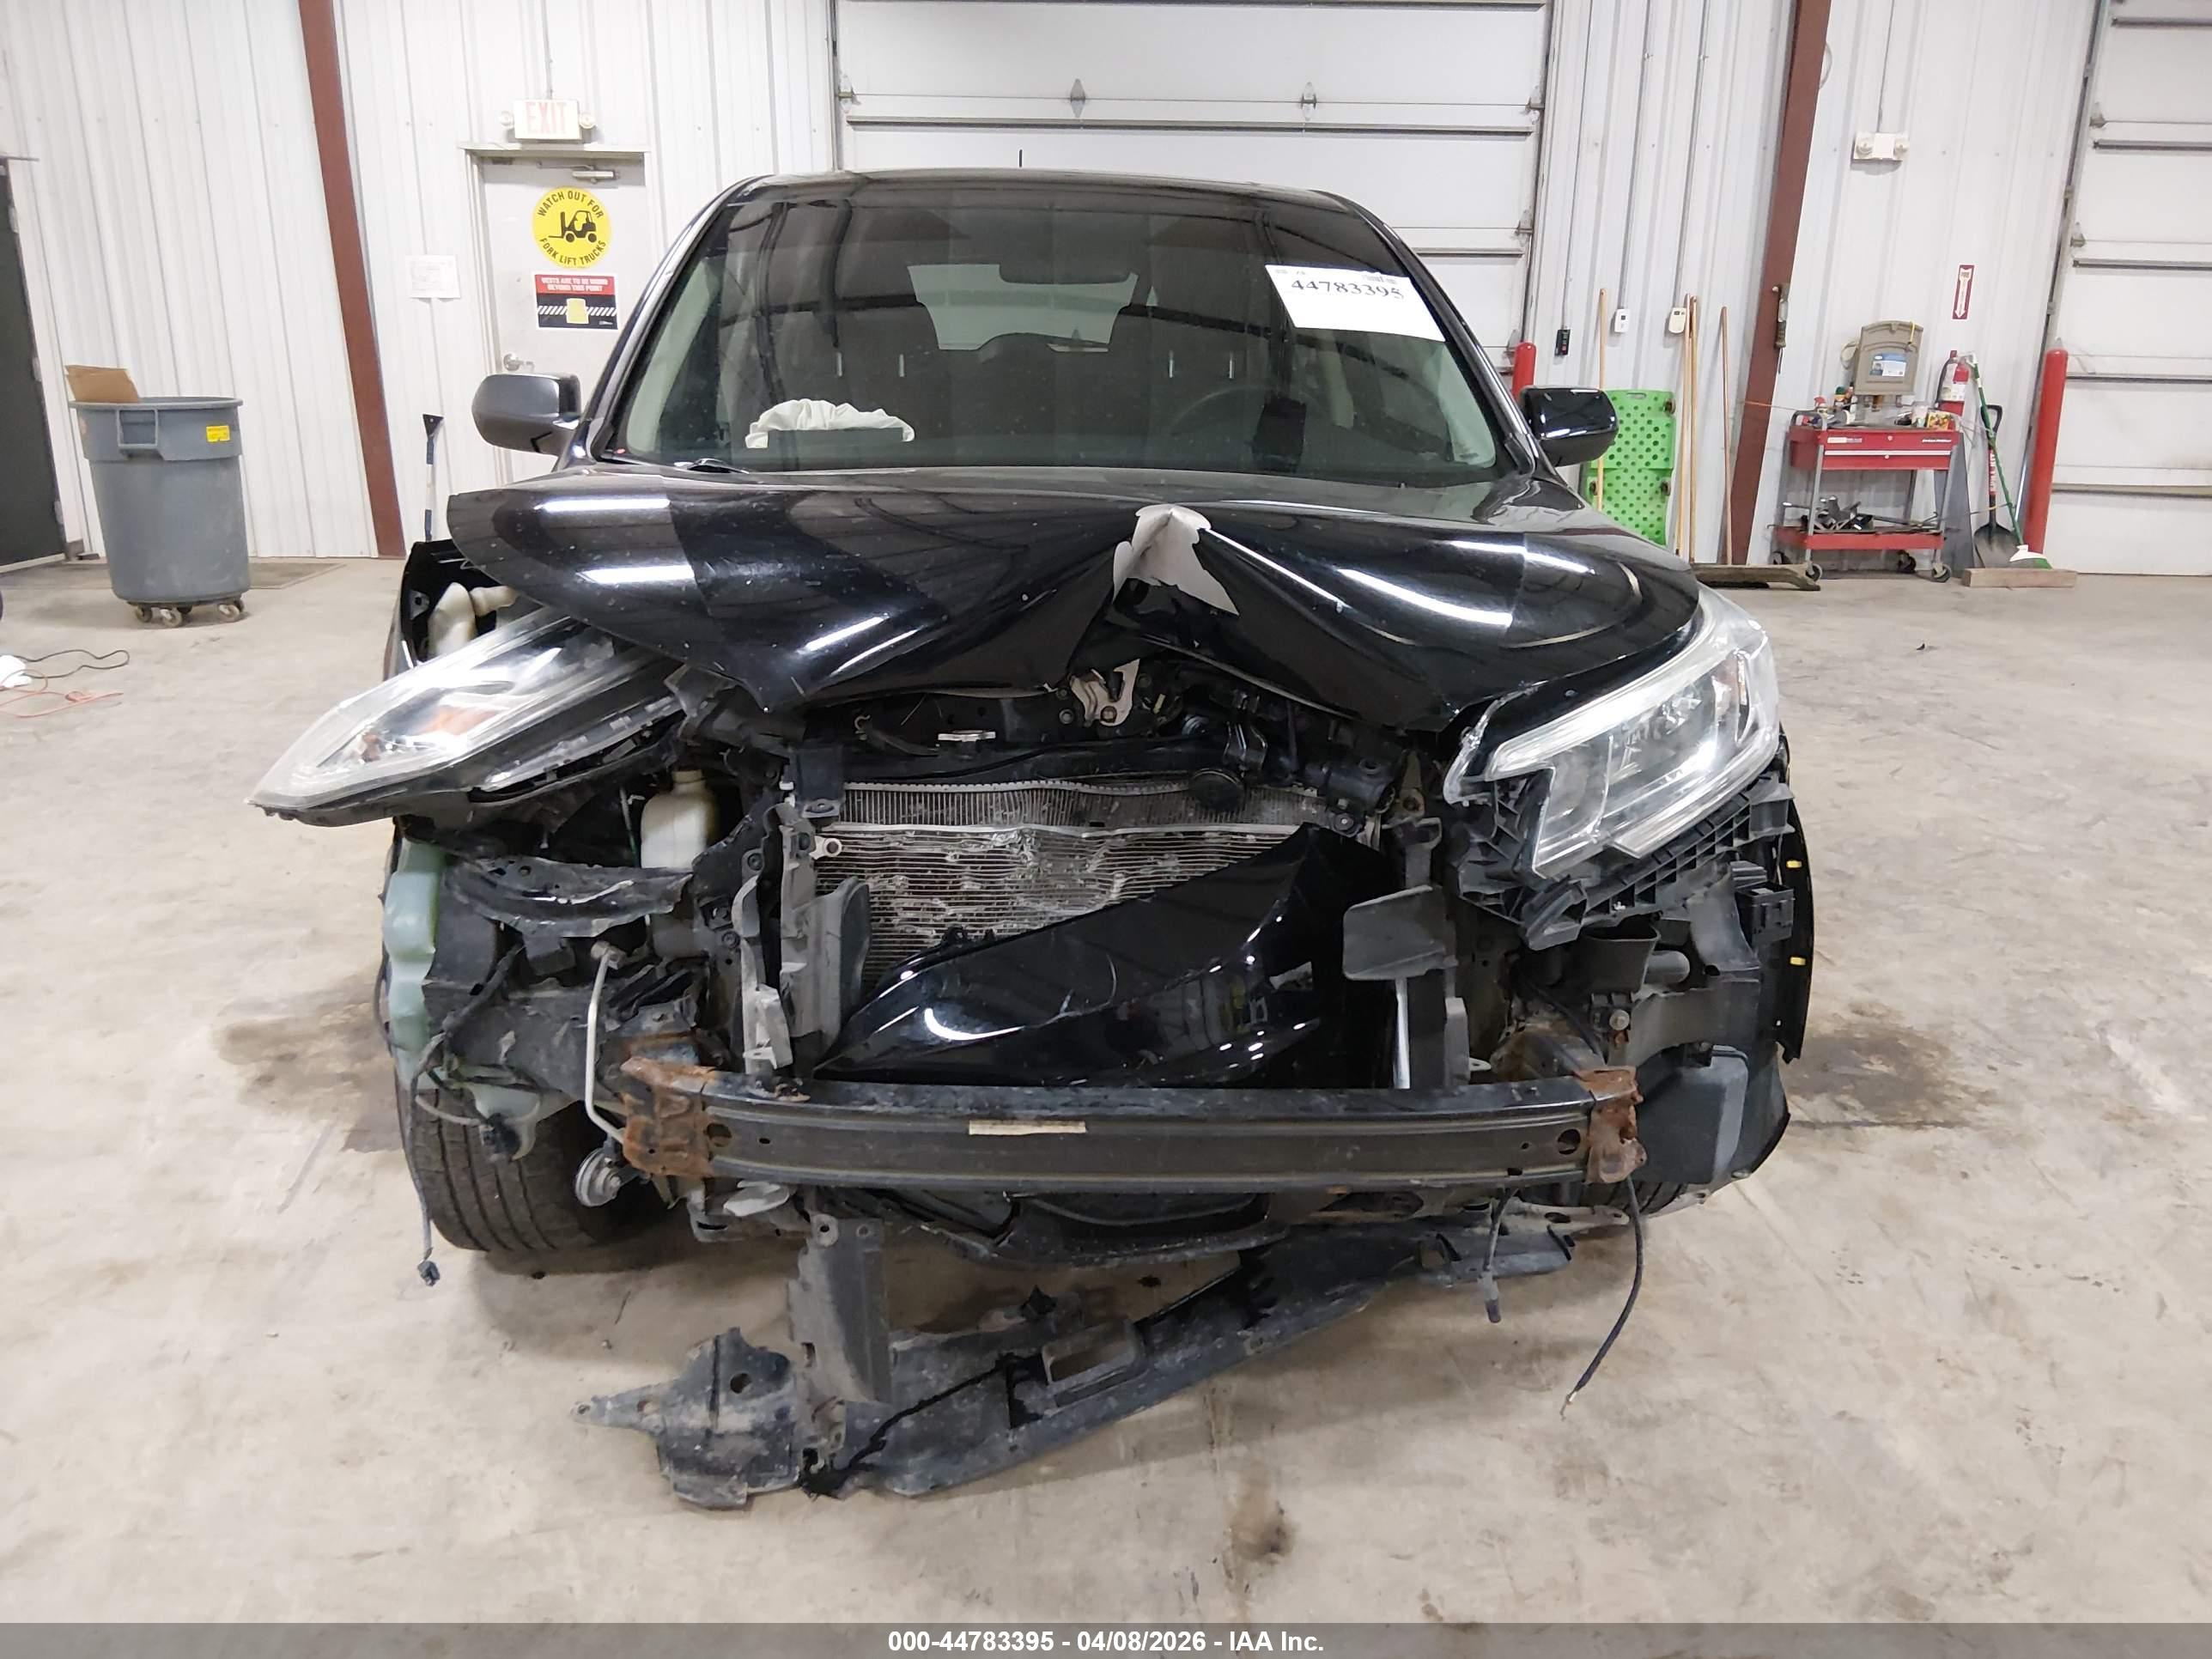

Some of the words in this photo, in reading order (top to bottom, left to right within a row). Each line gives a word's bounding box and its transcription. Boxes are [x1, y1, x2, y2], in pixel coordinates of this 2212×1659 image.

[525, 101, 567, 134] EXIT
[537, 191, 564, 216] WATCH
[568, 191, 586, 203] OUT
[587, 199, 604, 218] FOR
[539, 238, 559, 259] FORK
[559, 255, 577, 265] LIFT
[580, 240, 606, 265] TRUCKS
[1291, 279, 1405, 300] 44783395
